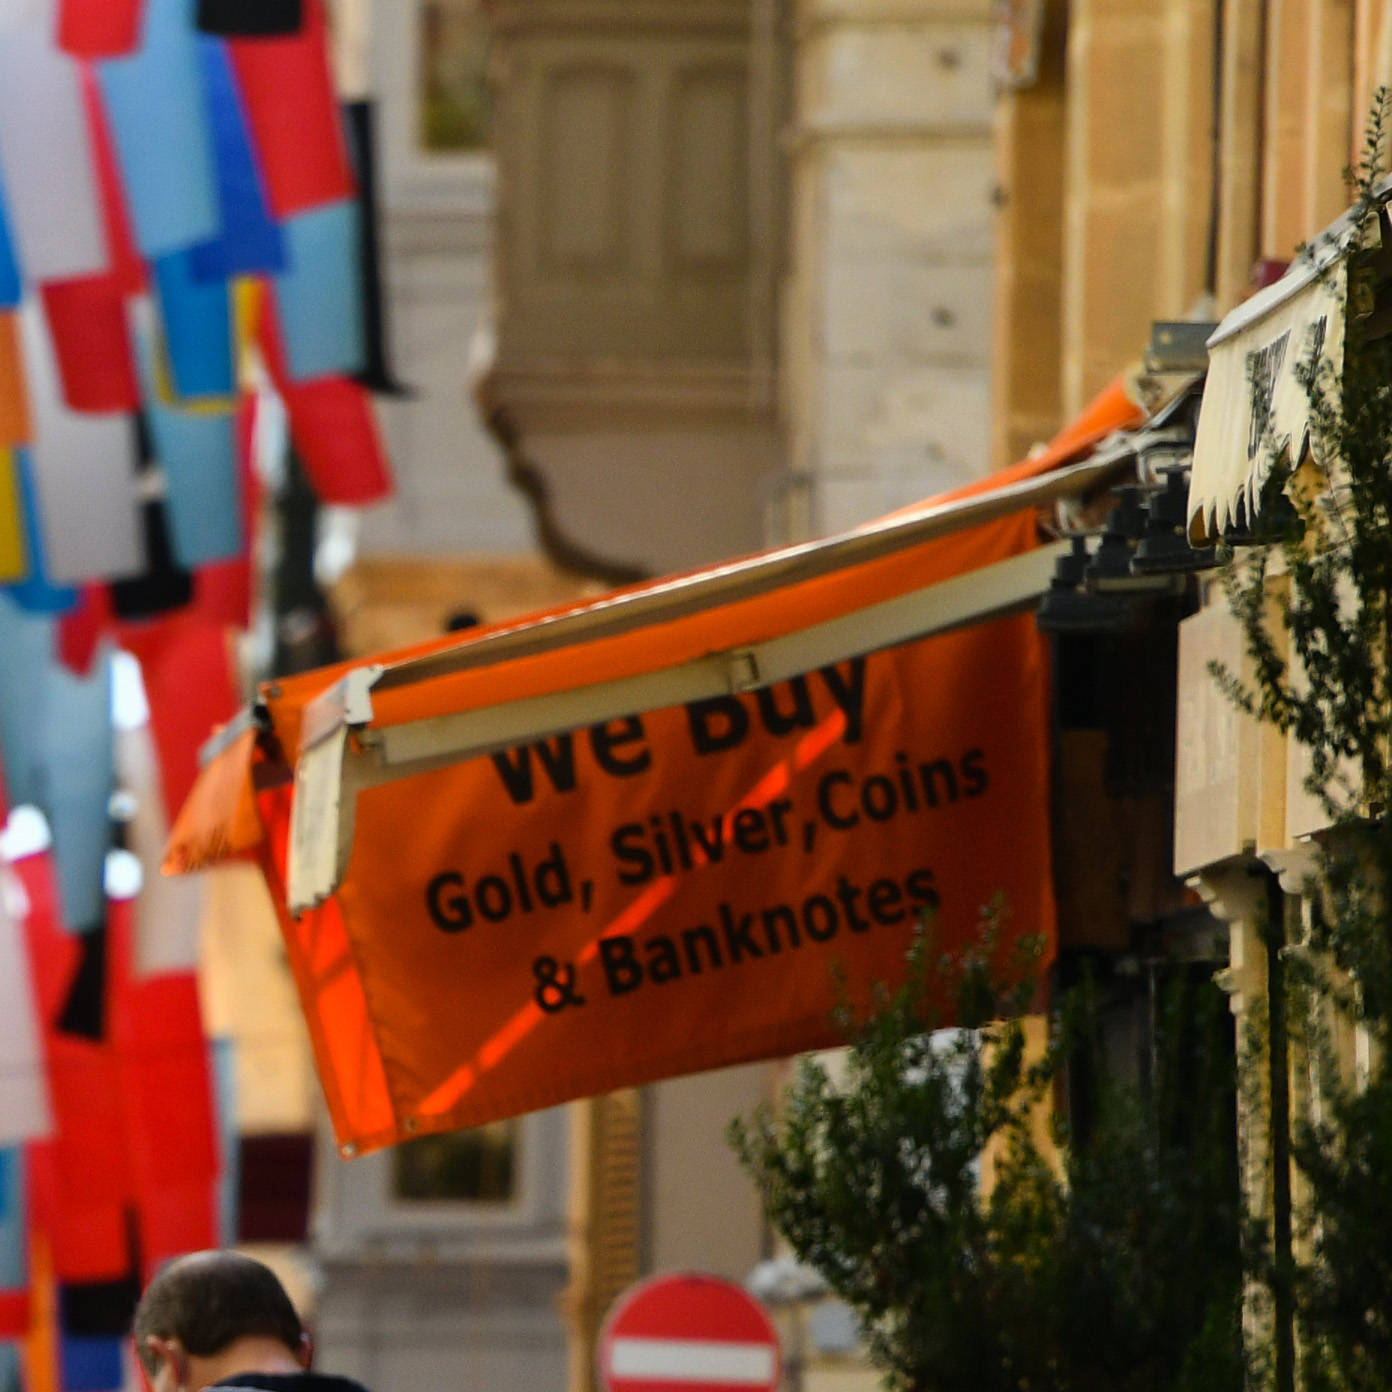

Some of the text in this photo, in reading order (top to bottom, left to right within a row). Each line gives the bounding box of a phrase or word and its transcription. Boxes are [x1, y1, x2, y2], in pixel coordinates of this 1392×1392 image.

[425, 841, 595, 934] Gold,
[532, 865, 941, 1014] & Banknotes
